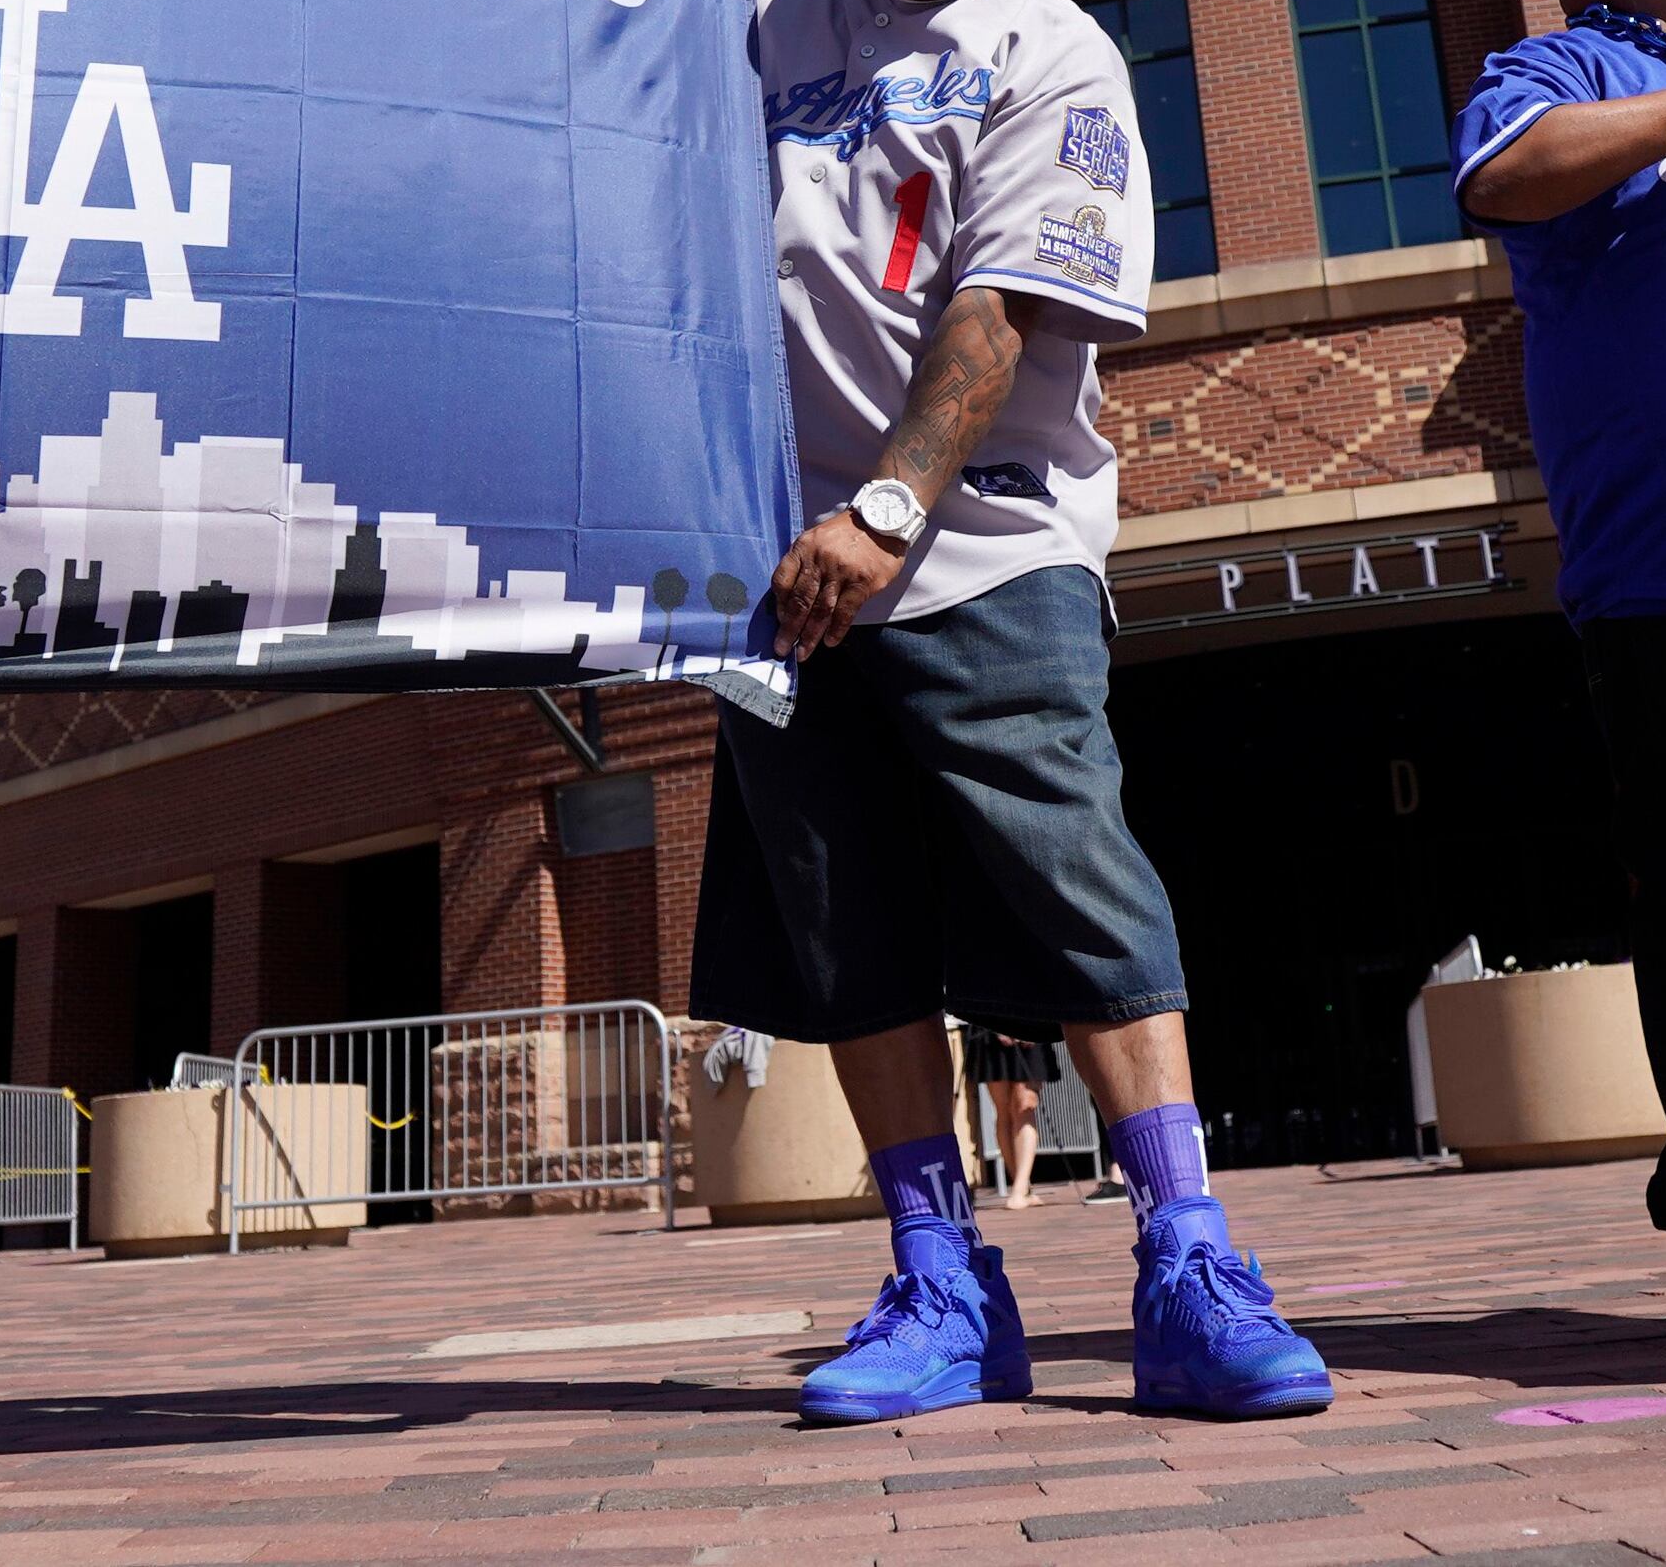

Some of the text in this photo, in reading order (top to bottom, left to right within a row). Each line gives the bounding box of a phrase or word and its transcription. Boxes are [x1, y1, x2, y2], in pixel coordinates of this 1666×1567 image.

[774, 49, 995, 162] Angeles
[1064, 136, 1126, 186] SERIES
[1071, 113, 1128, 163] WORLD
[882, 170, 931, 293] 1
[1042, 220, 1107, 257] CAMPEONES
[1039, 235, 1052, 252] LA
[1053, 241, 1082, 261] SERIE
[1081, 251, 1120, 280] MUNDIAL
[1219, 531, 1505, 612] PLATE
